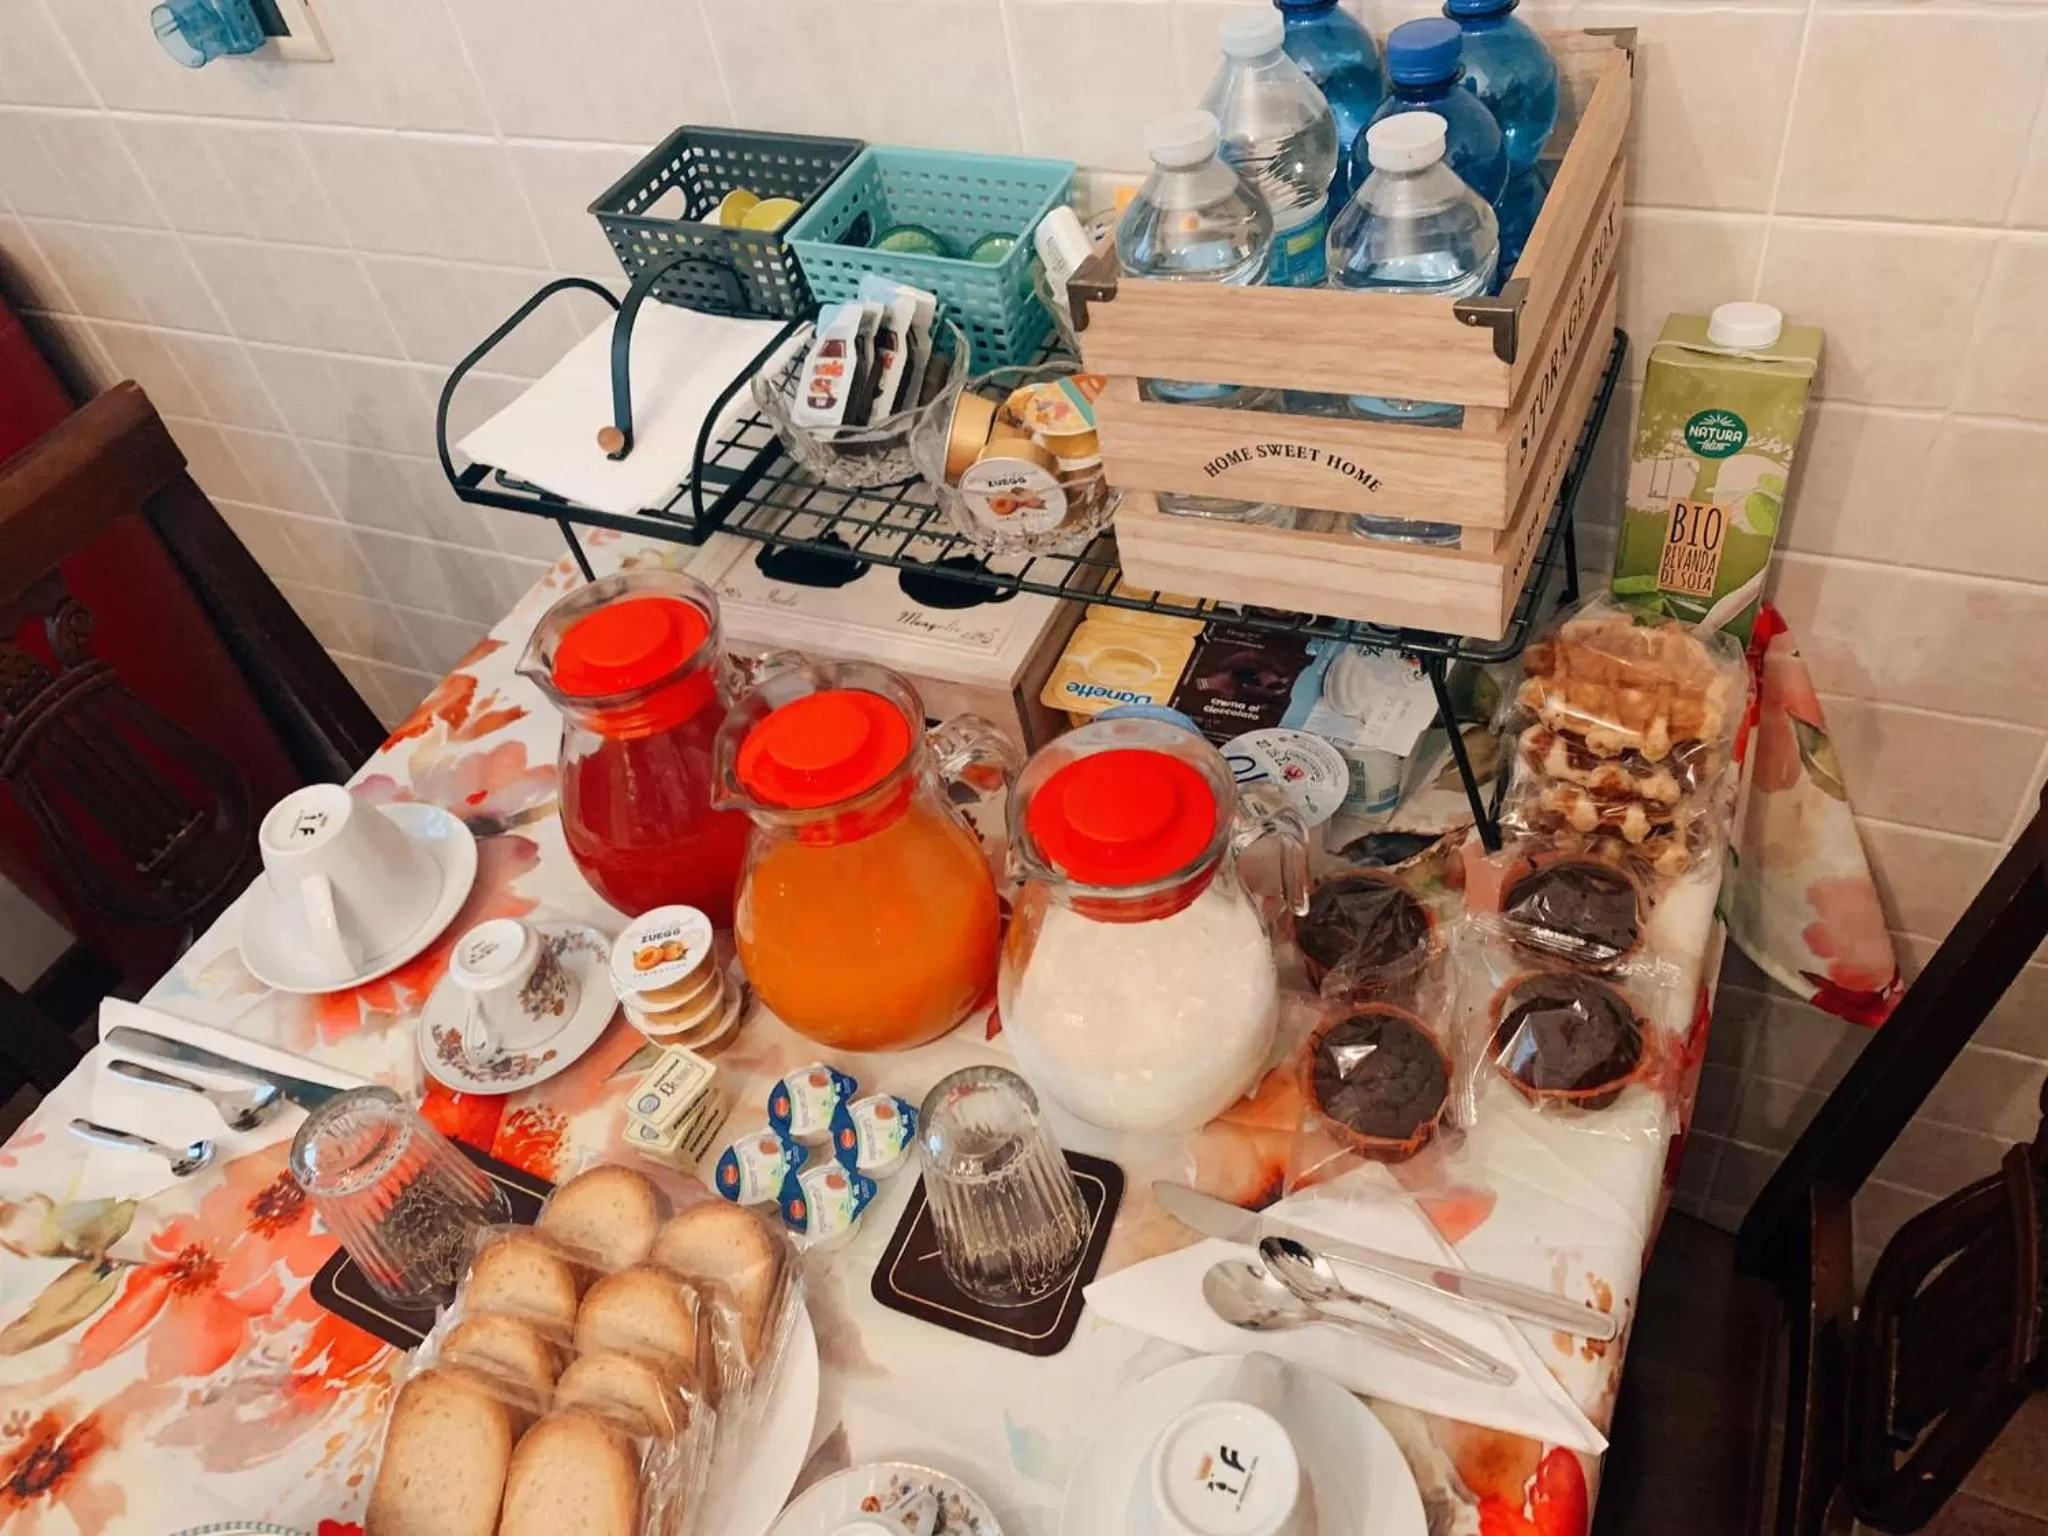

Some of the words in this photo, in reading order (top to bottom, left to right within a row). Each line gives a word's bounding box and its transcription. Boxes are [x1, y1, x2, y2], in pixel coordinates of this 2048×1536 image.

[1689, 425, 1743, 442] NATURA
[1203, 447, 1253, 479] HOME
[1255, 443, 1321, 462] SWEET
[1326, 454, 1384, 493] HOME
[1670, 502, 1722, 551] BIO
[1662, 543, 1717, 575] BEVANDA
[1660, 568, 1674, 585] DI
[1680, 573, 1713, 591] SOIA
